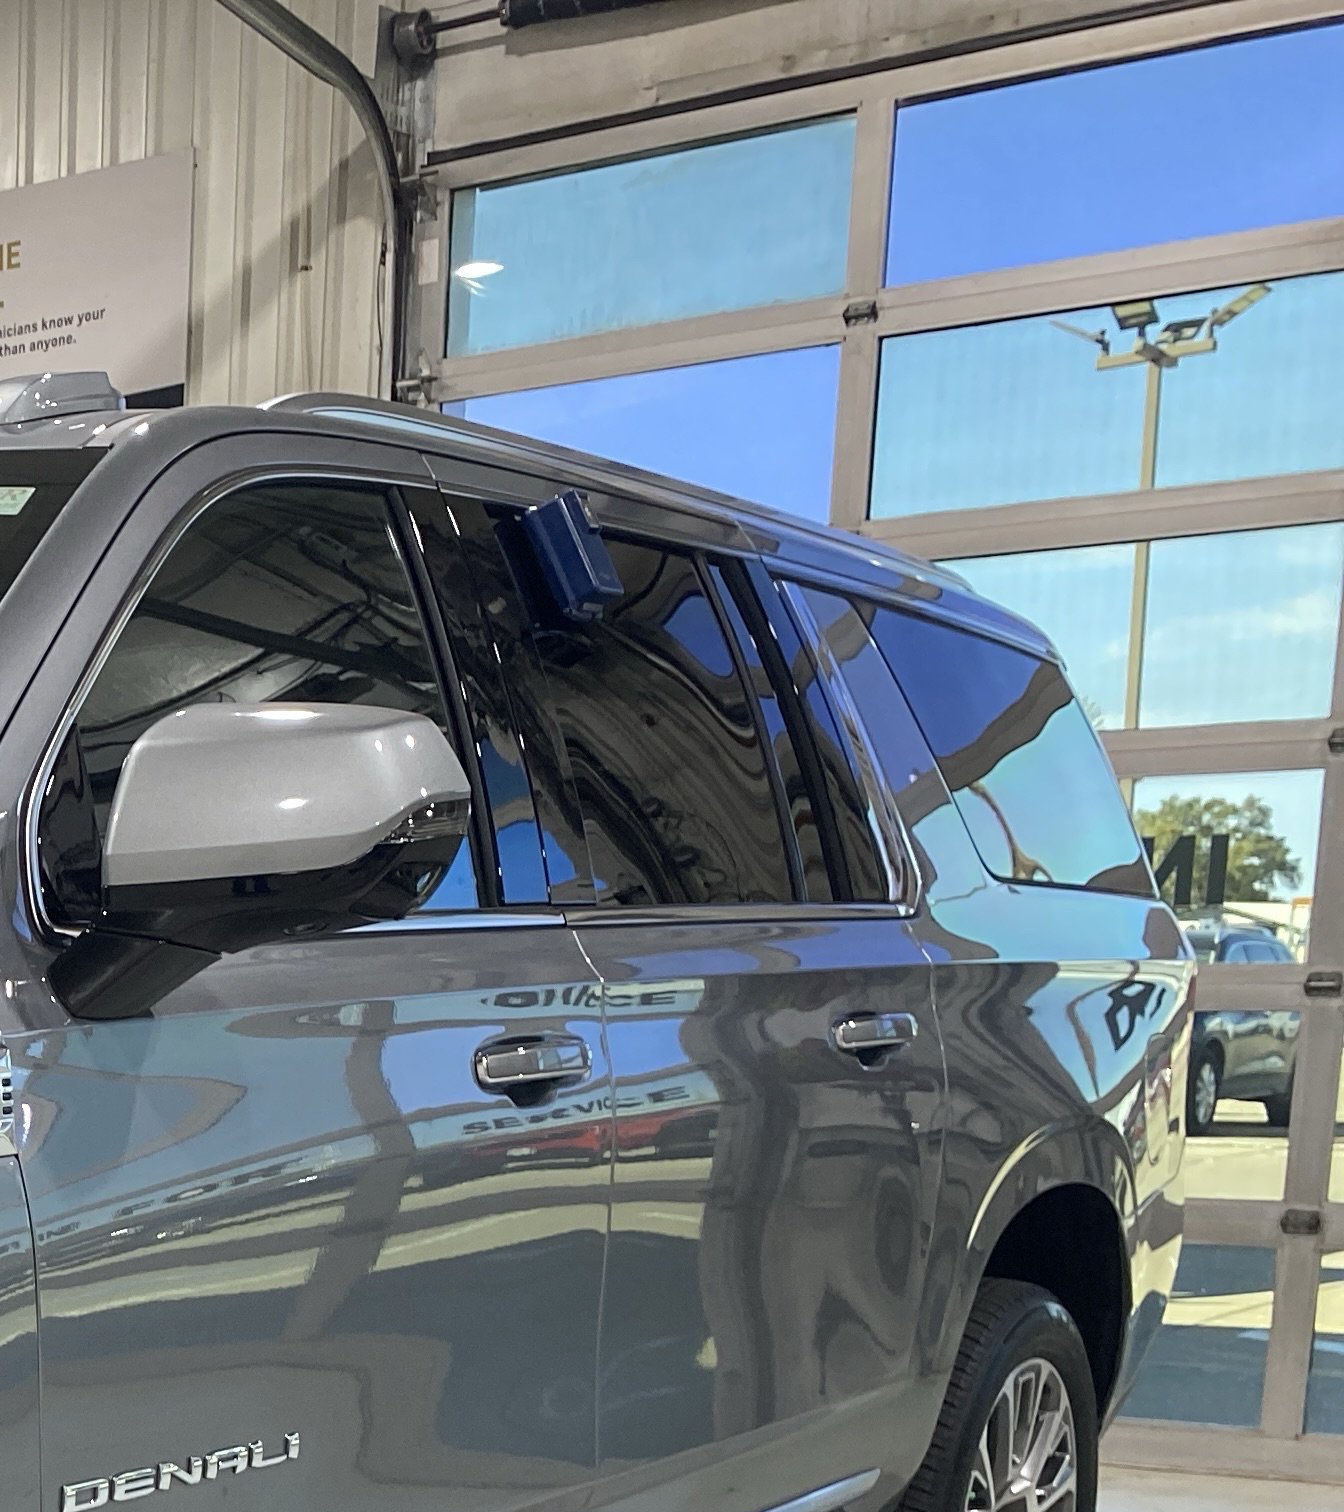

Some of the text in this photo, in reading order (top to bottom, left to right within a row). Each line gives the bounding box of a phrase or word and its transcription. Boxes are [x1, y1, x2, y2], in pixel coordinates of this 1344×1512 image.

[41, 314, 75, 331] know
[76, 308, 106, 326] your
[0, 342, 26, 357] than
[29, 334, 77, 353] anyone.
